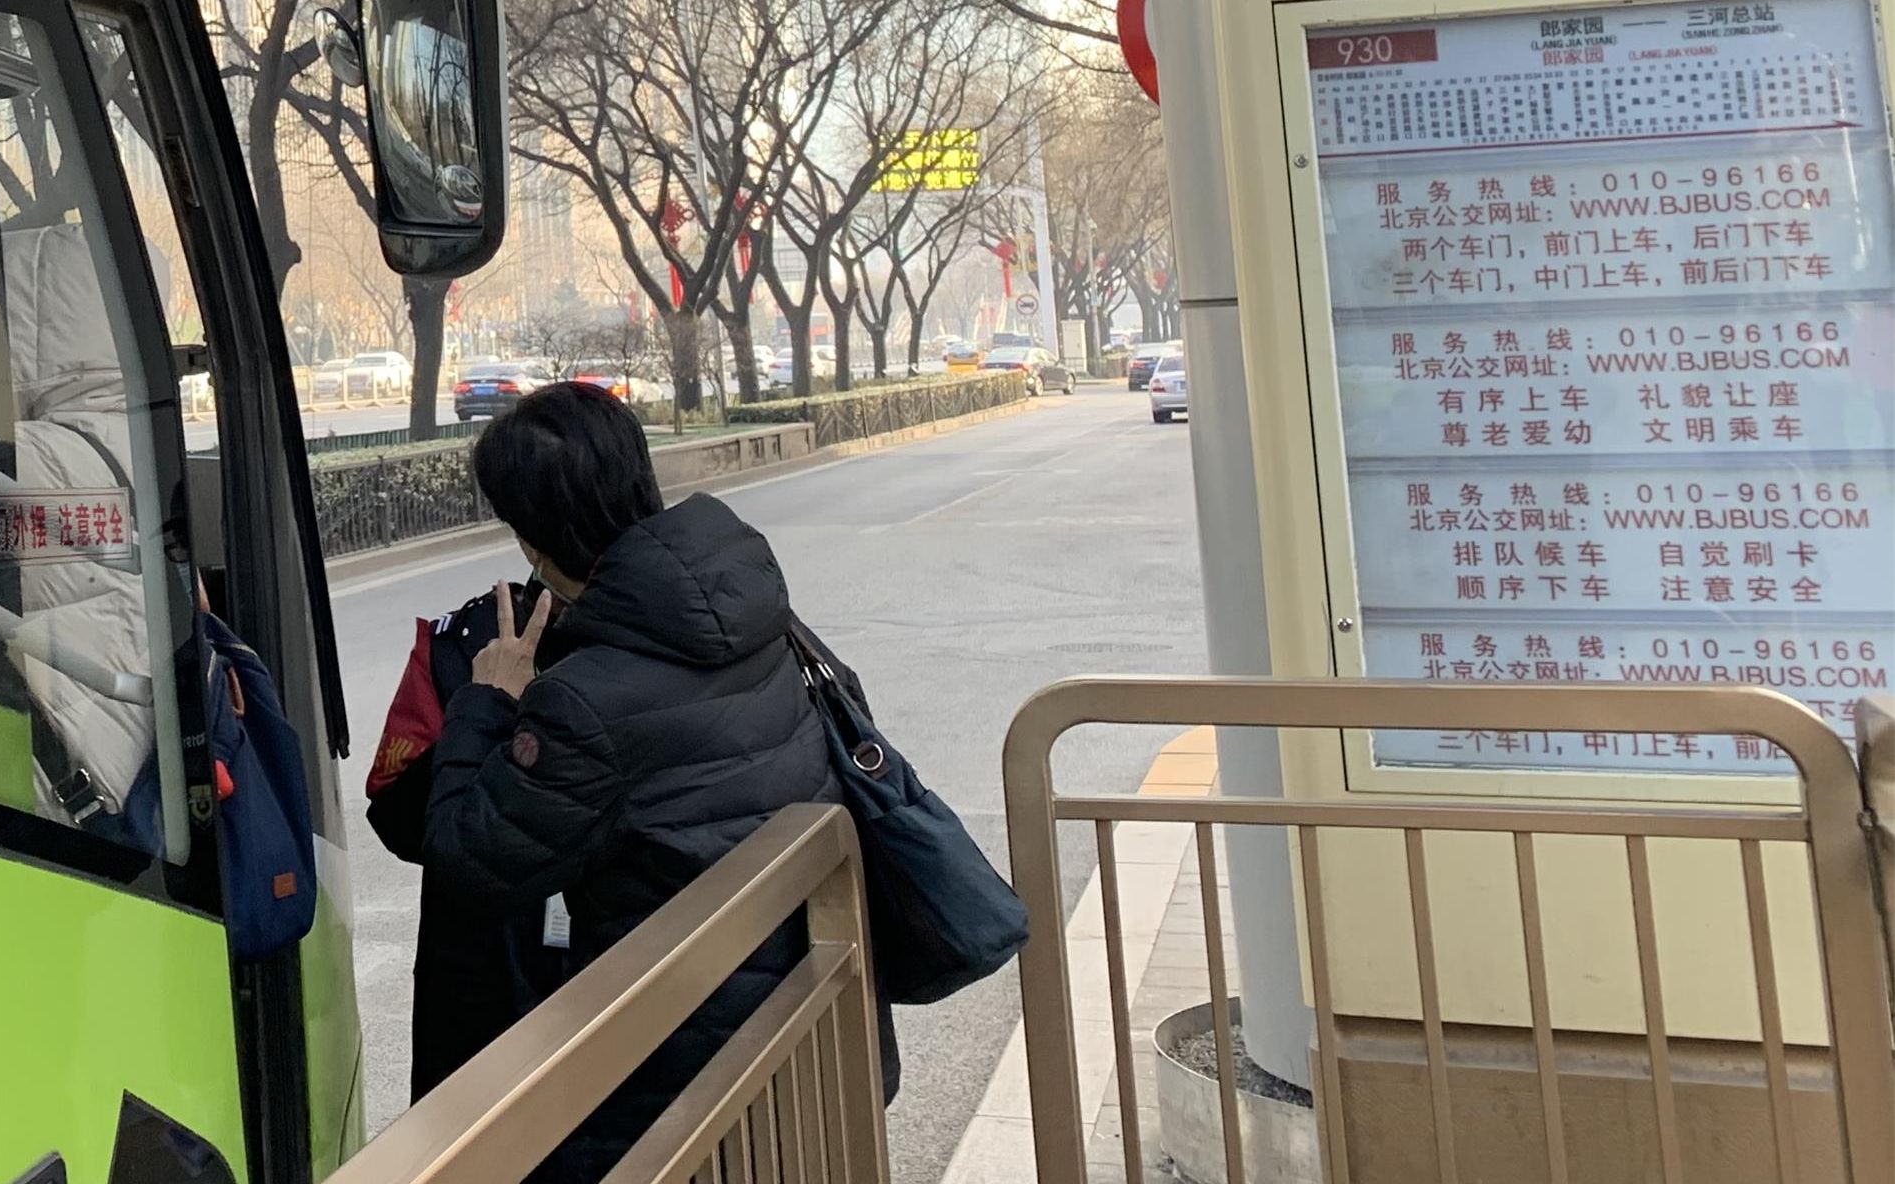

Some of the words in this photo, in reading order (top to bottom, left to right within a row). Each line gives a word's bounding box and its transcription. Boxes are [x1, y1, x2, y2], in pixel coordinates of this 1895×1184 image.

[1541, 16, 1604, 37] 郎家园
[1687, 3, 1776, 27] 三河总站
[1338, 36, 1392, 65] 930
[1543, 46, 1604, 65] 郎家园
[1570, 187, 1832, 220] WWW.BJBUS.COM
[1587, 347, 1850, 374] WWW.BJBUS.COM
[1437, 385, 1589, 414] 有序上车
[1638, 381, 1800, 410] 礼貌让座
[1441, 420, 1592, 447] 尊老爱幼
[1642, 415, 1804, 444] 文明乘车
[58, 502, 123, 546] 注意安全
[1603, 508, 1870, 530] WWW.BJBUS.COM
[1453, 540, 1607, 567] 排队候车
[1659, 540, 1819, 568] 自觉刷卡
[1457, 575, 1610, 602] 顺序下车
[1661, 575, 1822, 603] 注意安全
[1619, 664, 1888, 689] WWWBJBUS.COM
